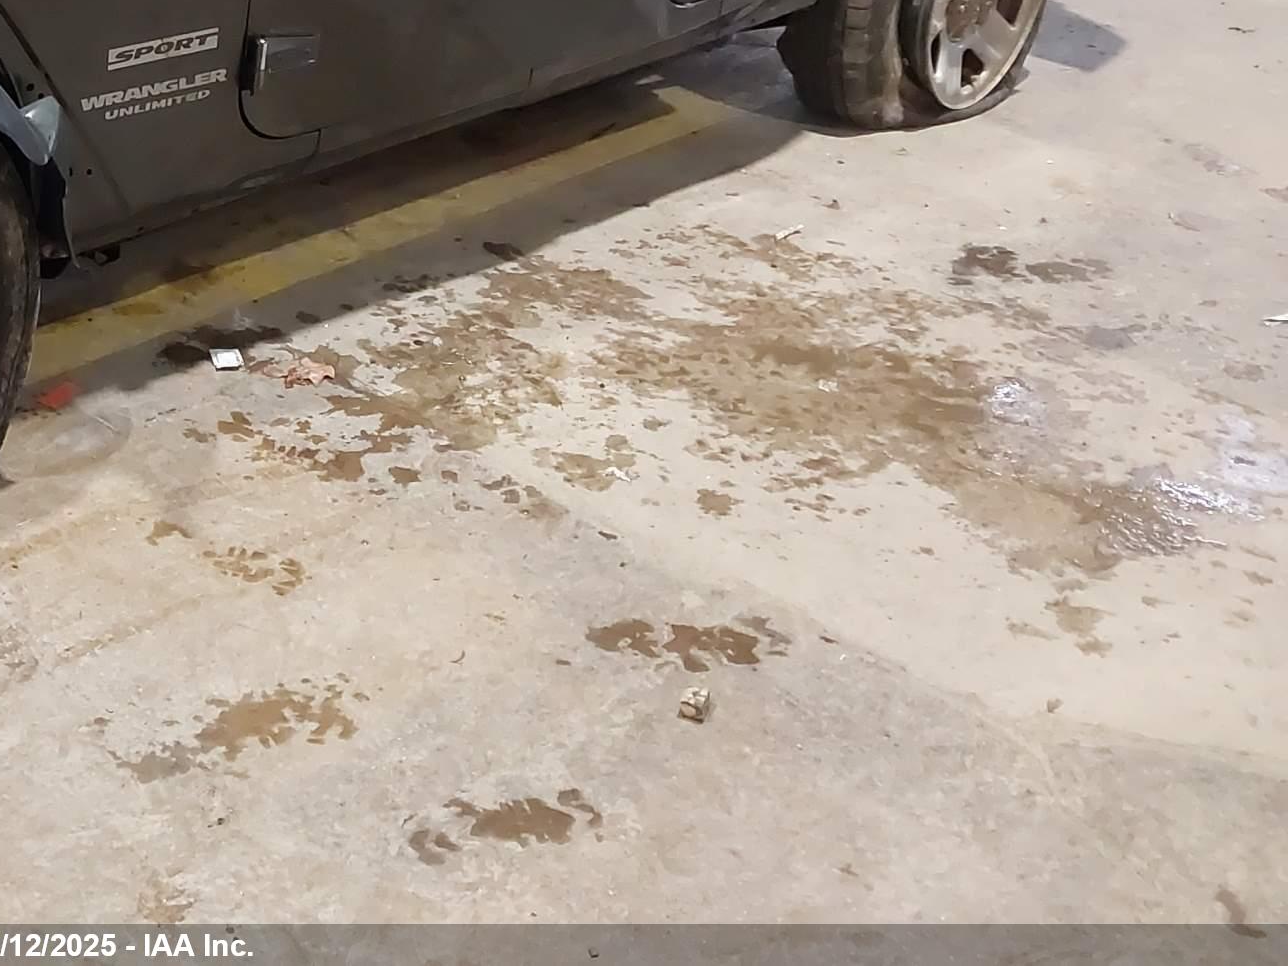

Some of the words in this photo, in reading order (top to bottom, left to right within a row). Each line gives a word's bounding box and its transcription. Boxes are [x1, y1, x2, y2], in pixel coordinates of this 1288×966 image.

[112, 33, 215, 65] SPORT
[80, 68, 228, 112] WRANGLER
[104, 89, 211, 121] UNLIMITED
